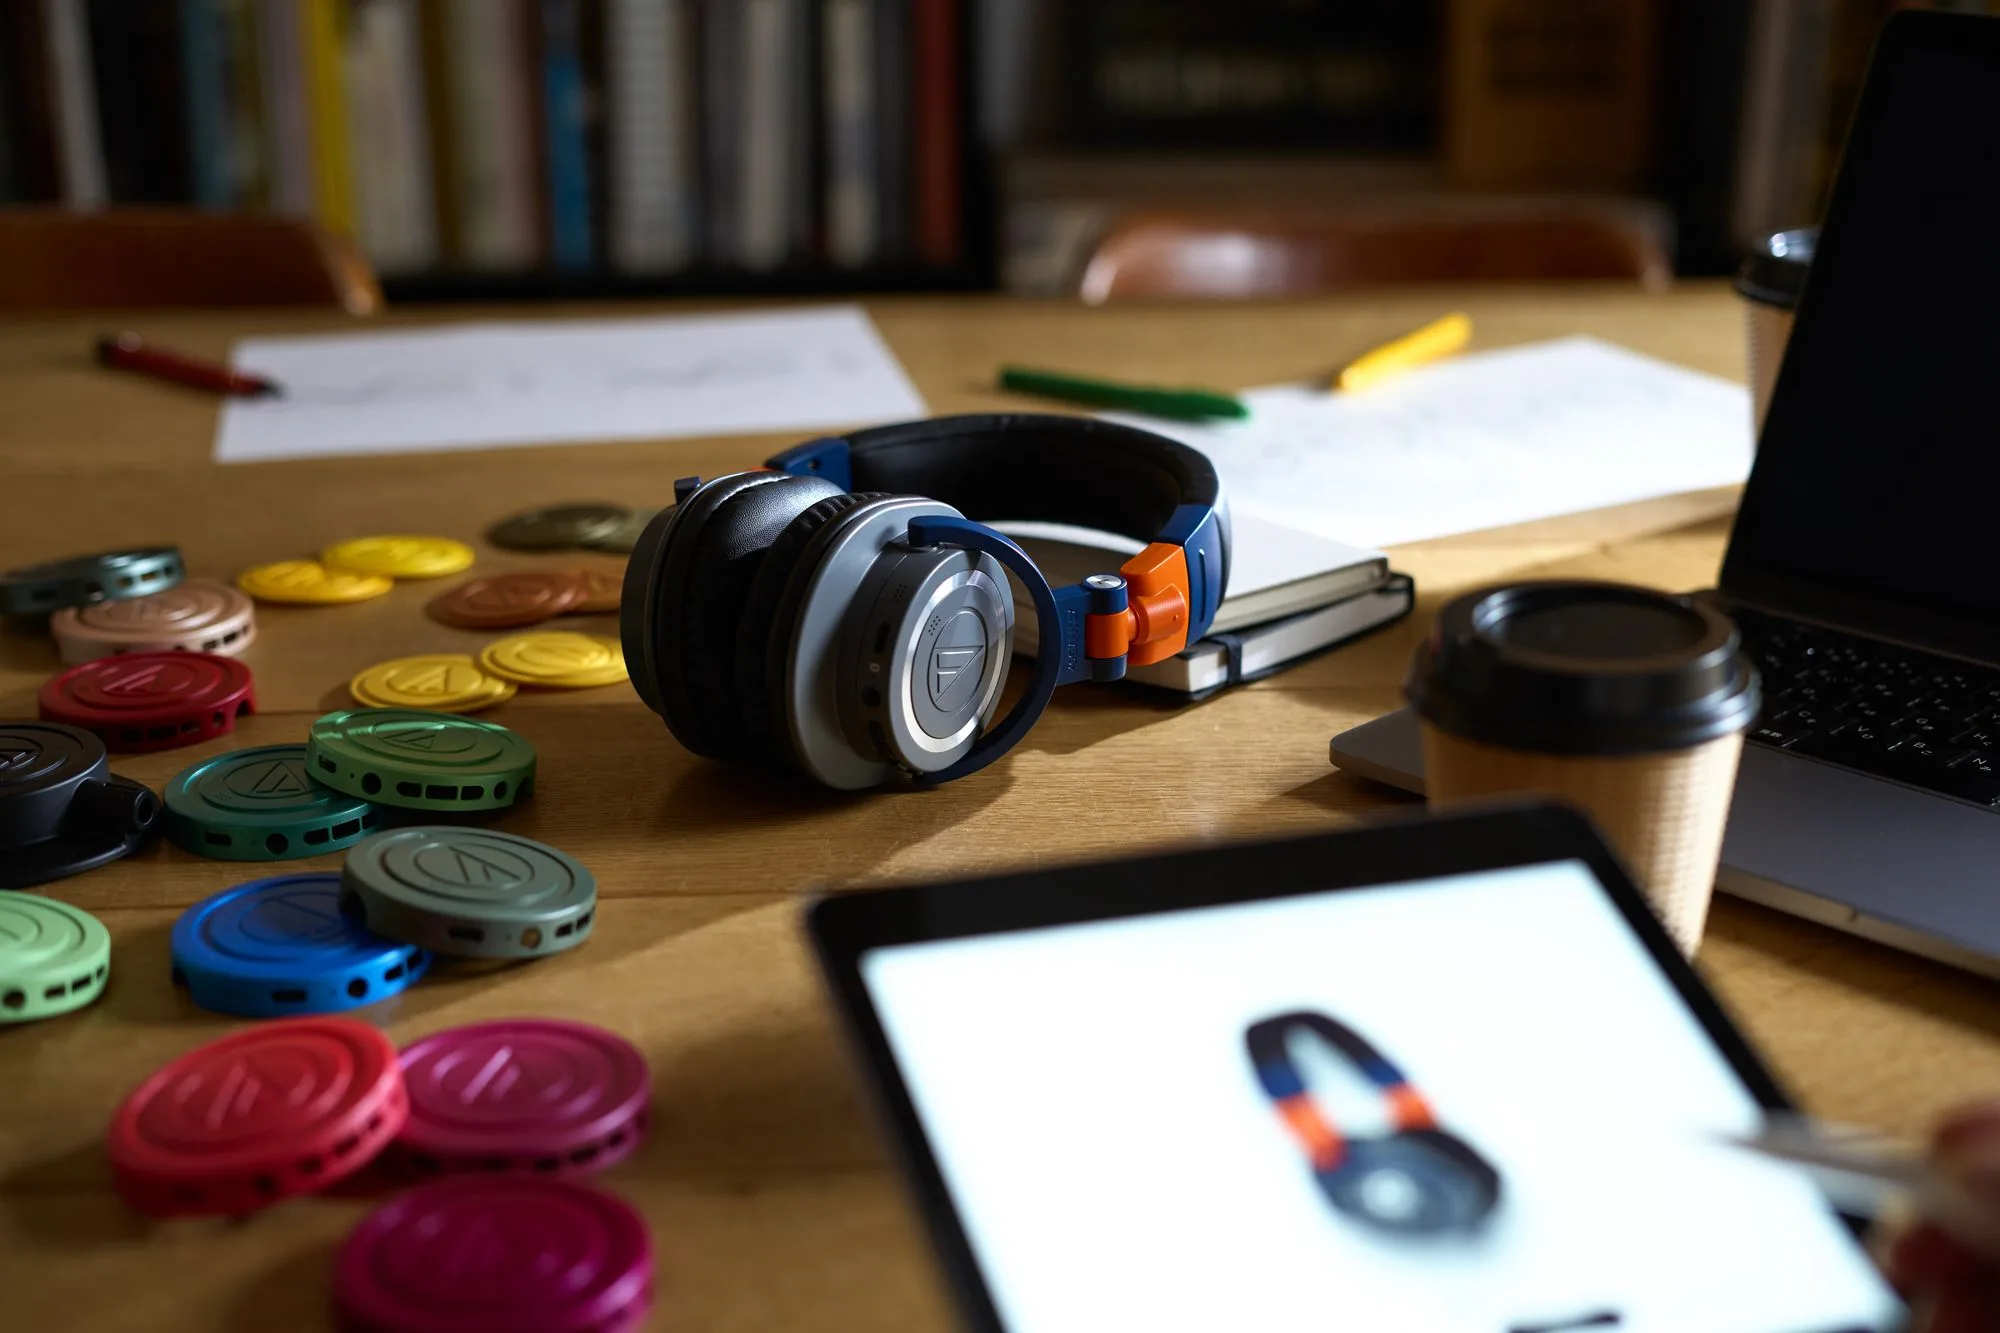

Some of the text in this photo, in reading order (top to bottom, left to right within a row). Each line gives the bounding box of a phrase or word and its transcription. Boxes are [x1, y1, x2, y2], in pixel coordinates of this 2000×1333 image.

[1798, 709, 1812, 718] C
[1973, 732, 1988, 740] H
[1913, 741, 1926, 749] B
[1972, 757, 1987, 765] N
